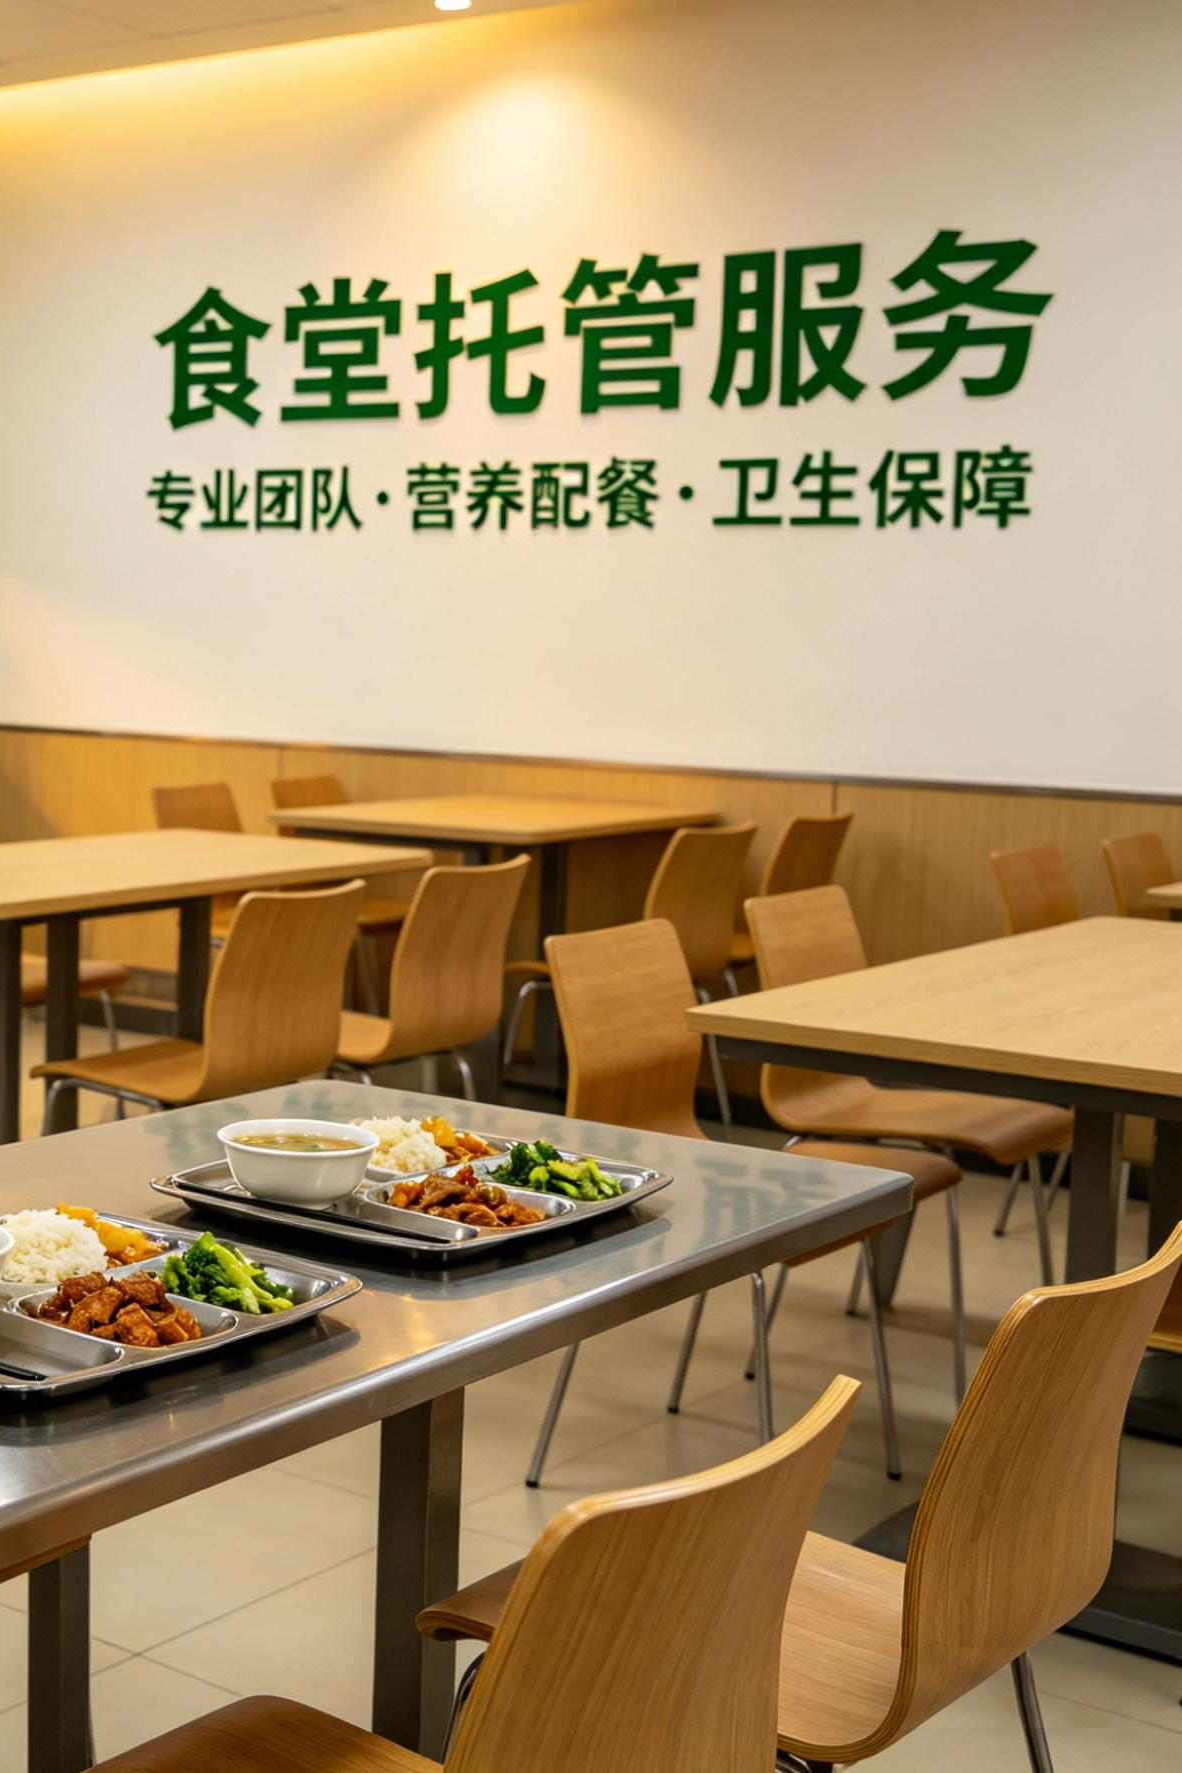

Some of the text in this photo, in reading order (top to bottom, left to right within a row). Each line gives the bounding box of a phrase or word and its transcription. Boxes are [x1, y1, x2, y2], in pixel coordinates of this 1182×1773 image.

[153, 229, 1054, 431] 食堂托管服务
